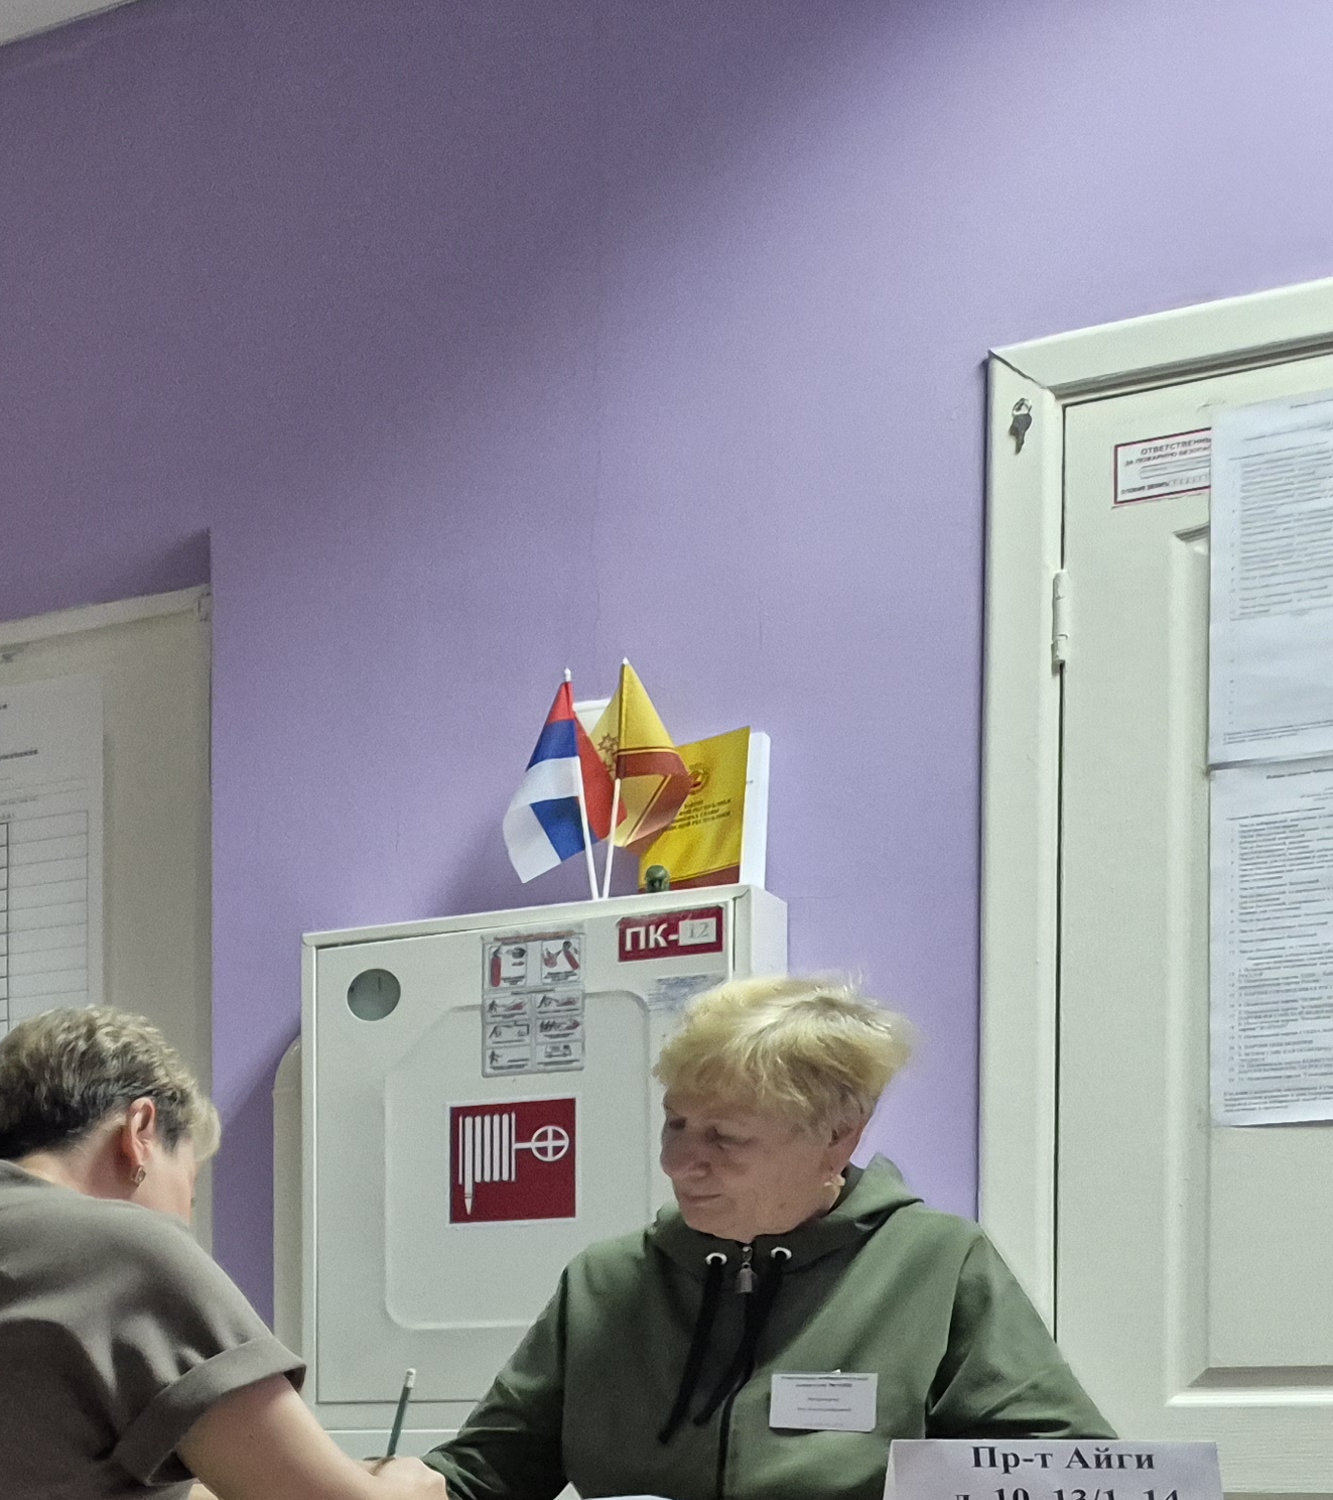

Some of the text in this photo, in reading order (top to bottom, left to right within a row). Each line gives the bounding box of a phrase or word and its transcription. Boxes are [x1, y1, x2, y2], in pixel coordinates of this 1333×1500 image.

[1141, 438, 1211, 455] ОТВЕТСТВЕННЫ
[971, 1446, 1155, 1474] Пр-т Айги
